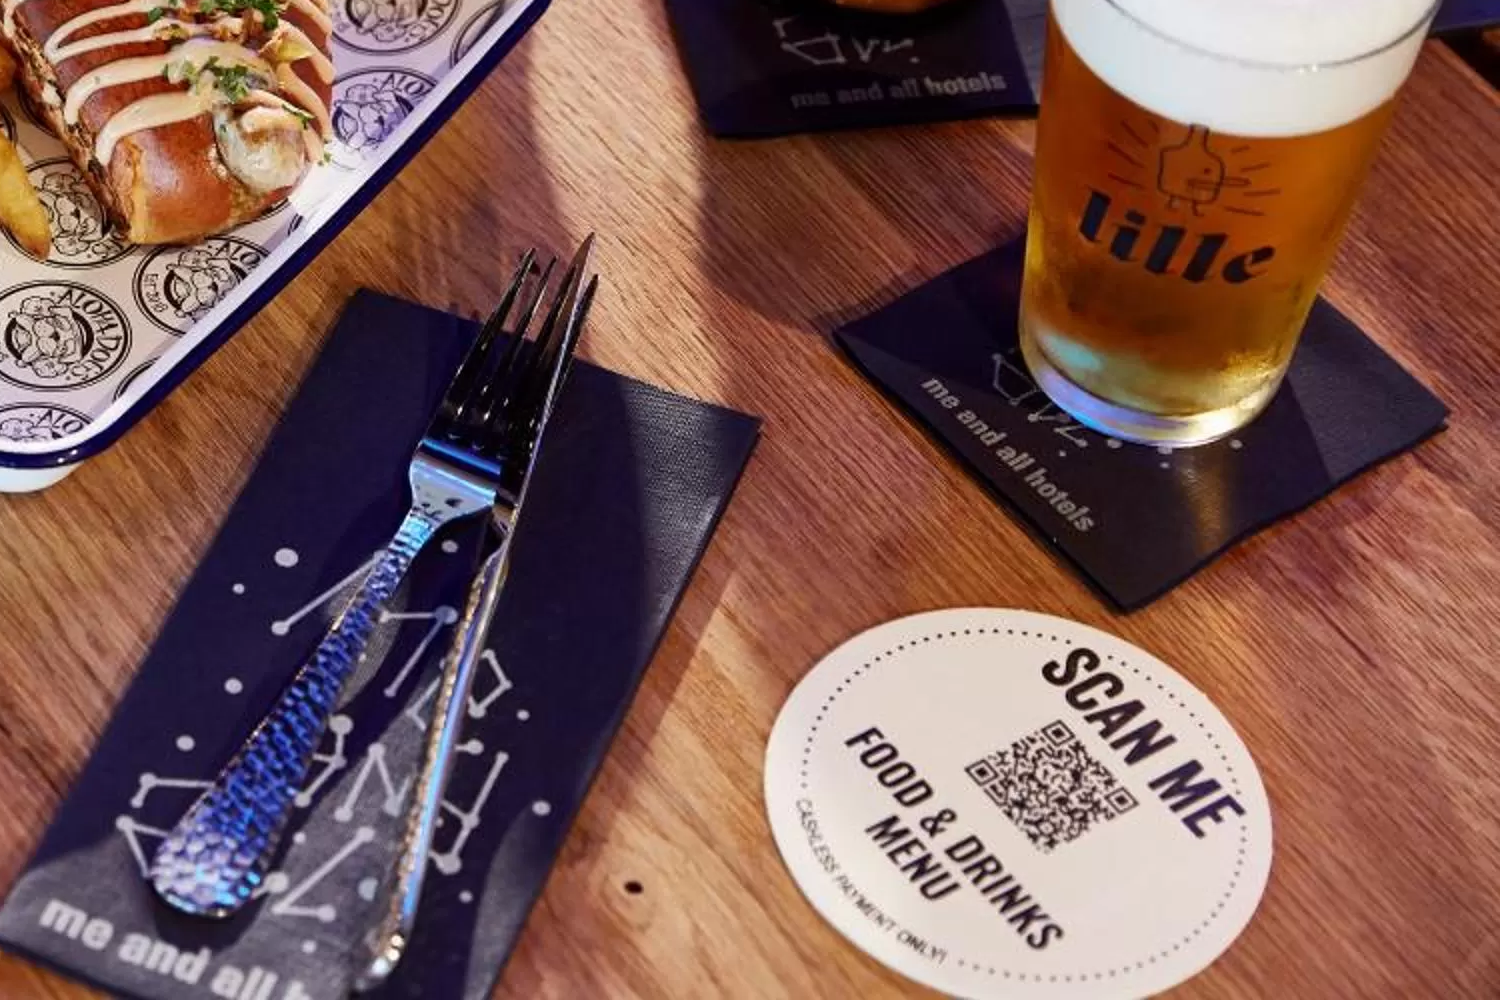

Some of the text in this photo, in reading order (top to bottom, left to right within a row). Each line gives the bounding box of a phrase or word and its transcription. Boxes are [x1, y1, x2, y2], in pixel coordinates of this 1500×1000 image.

[791, 71, 1008, 109] me and all hotels
[1079, 187, 1276, 284] lille
[920, 377, 1095, 532] me and all hotels
[1042, 647, 1247, 839] SCAN ME
[796, 798, 949, 966] CASHLESS PAYMENT ONLY!
[844, 726, 1064, 951] FOOD & DRINKS
[864, 814, 961, 901] MENU
[39, 898, 114, 950] me
[118, 932, 212, 985] and
[210, 964, 279, 1000] all
